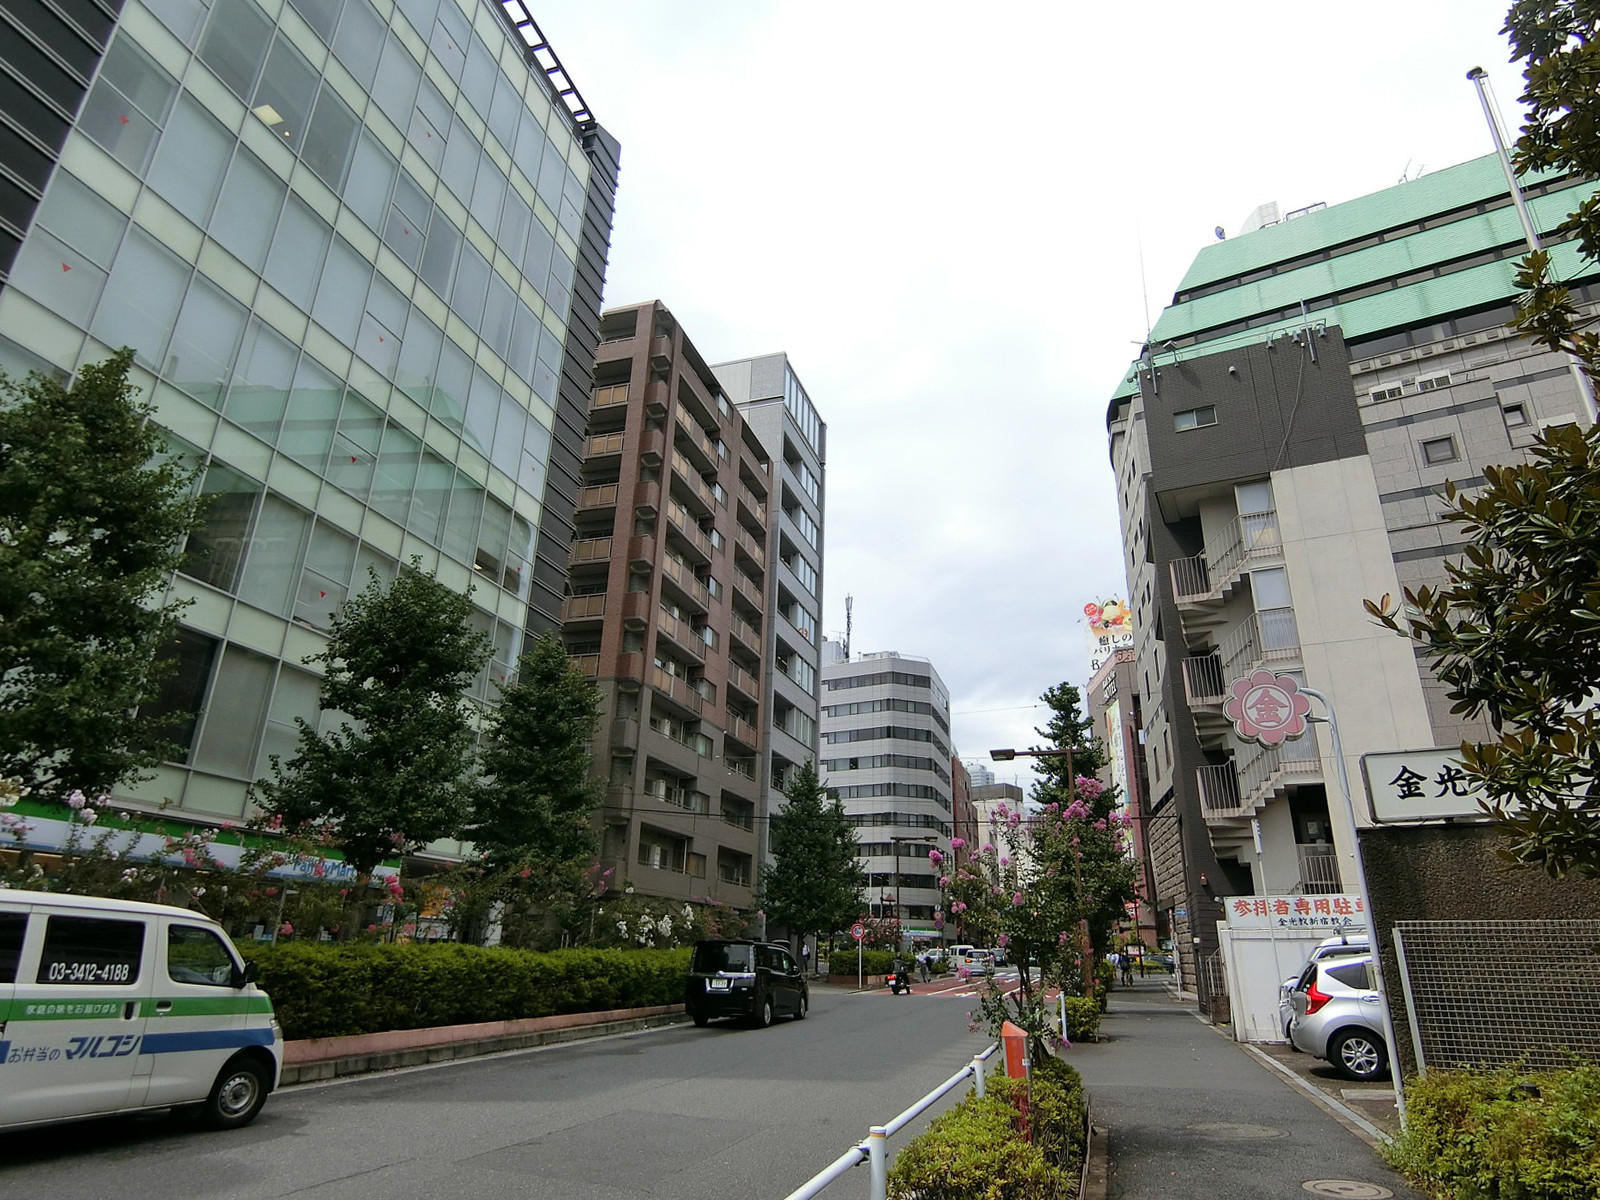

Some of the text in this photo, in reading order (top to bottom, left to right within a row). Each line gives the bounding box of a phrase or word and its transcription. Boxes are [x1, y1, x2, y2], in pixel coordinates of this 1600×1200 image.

[1247, 689, 1289, 723] 金
[1278, 917, 1353, 926] 金光教新宿教会
[49, 962, 130, 981] 03-3412-4188
